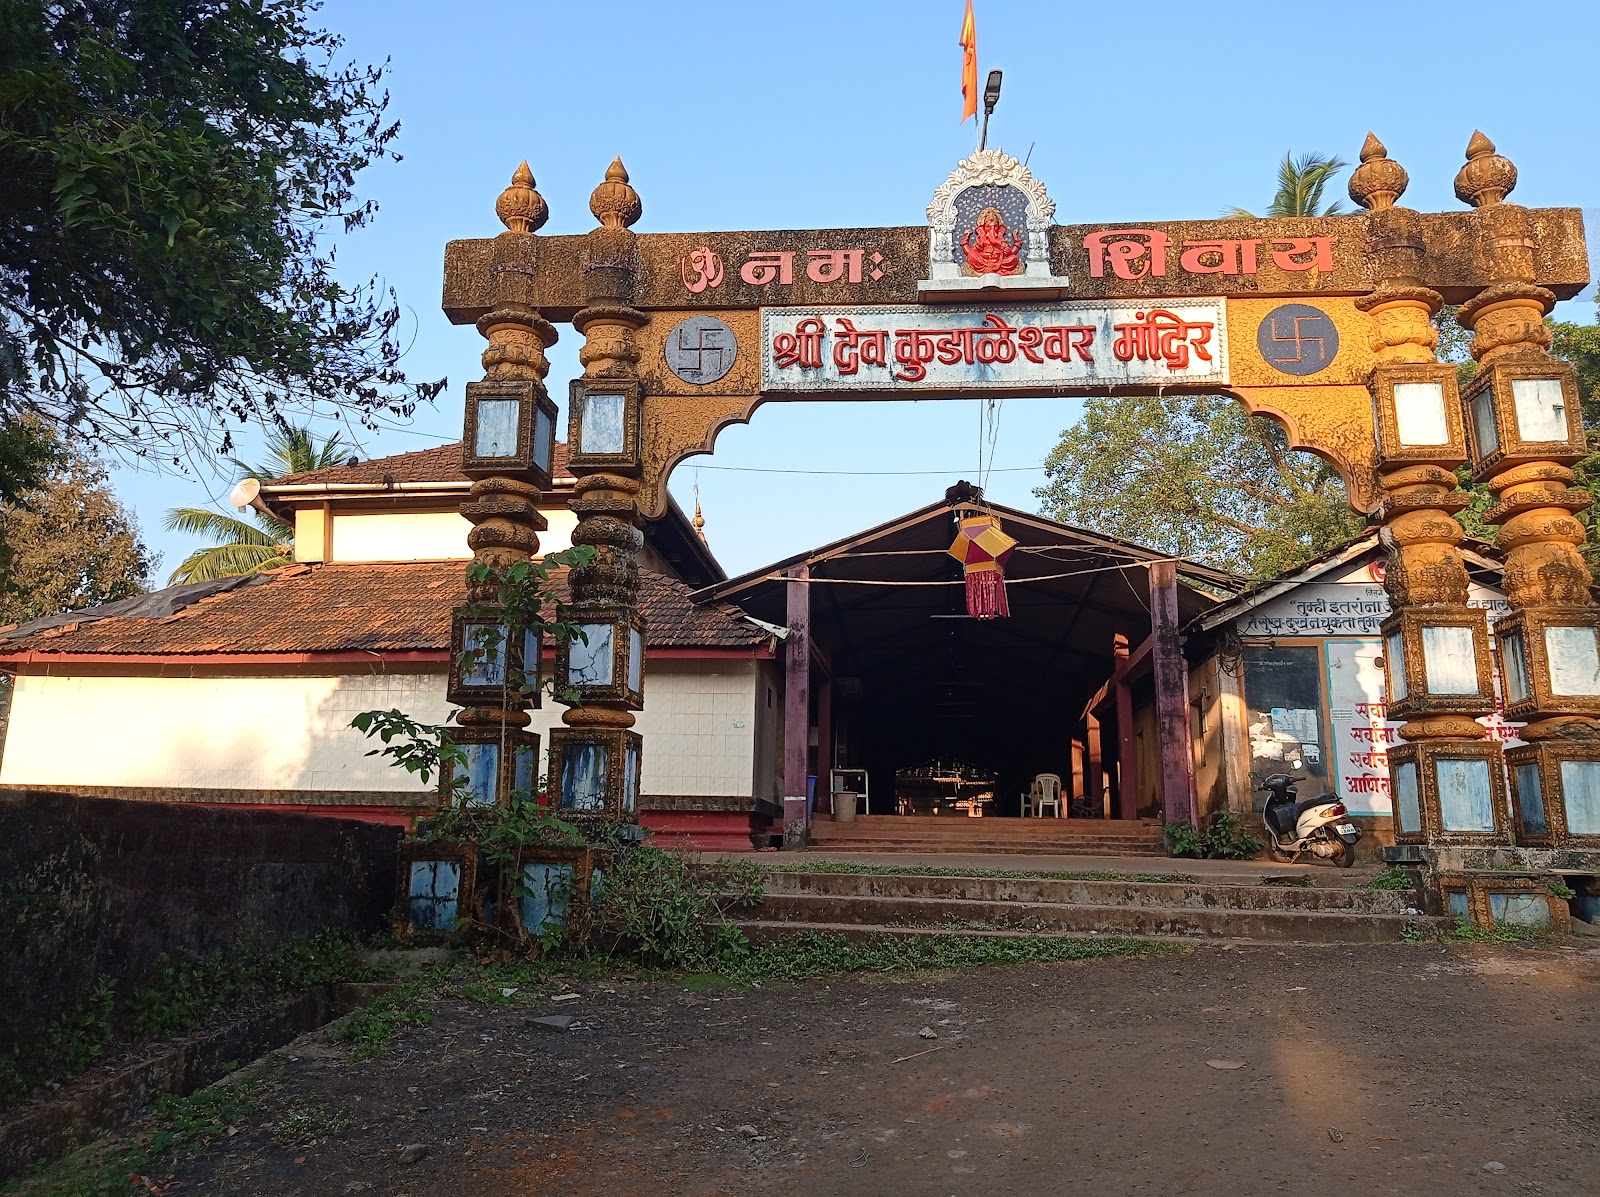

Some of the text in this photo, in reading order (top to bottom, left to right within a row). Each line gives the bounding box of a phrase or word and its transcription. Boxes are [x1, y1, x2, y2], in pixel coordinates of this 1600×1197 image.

[740, 249, 885, 285] नमः
[1083, 228, 1337, 280] शिवाय
[773, 309, 1214, 381] श्री देव कुडाळेश्वर मंदिर
[1329, 598, 1381, 615] इतरांना
[1350, 721, 1395, 743] सर्वांना
[1345, 773, 1380, 793] आणि
